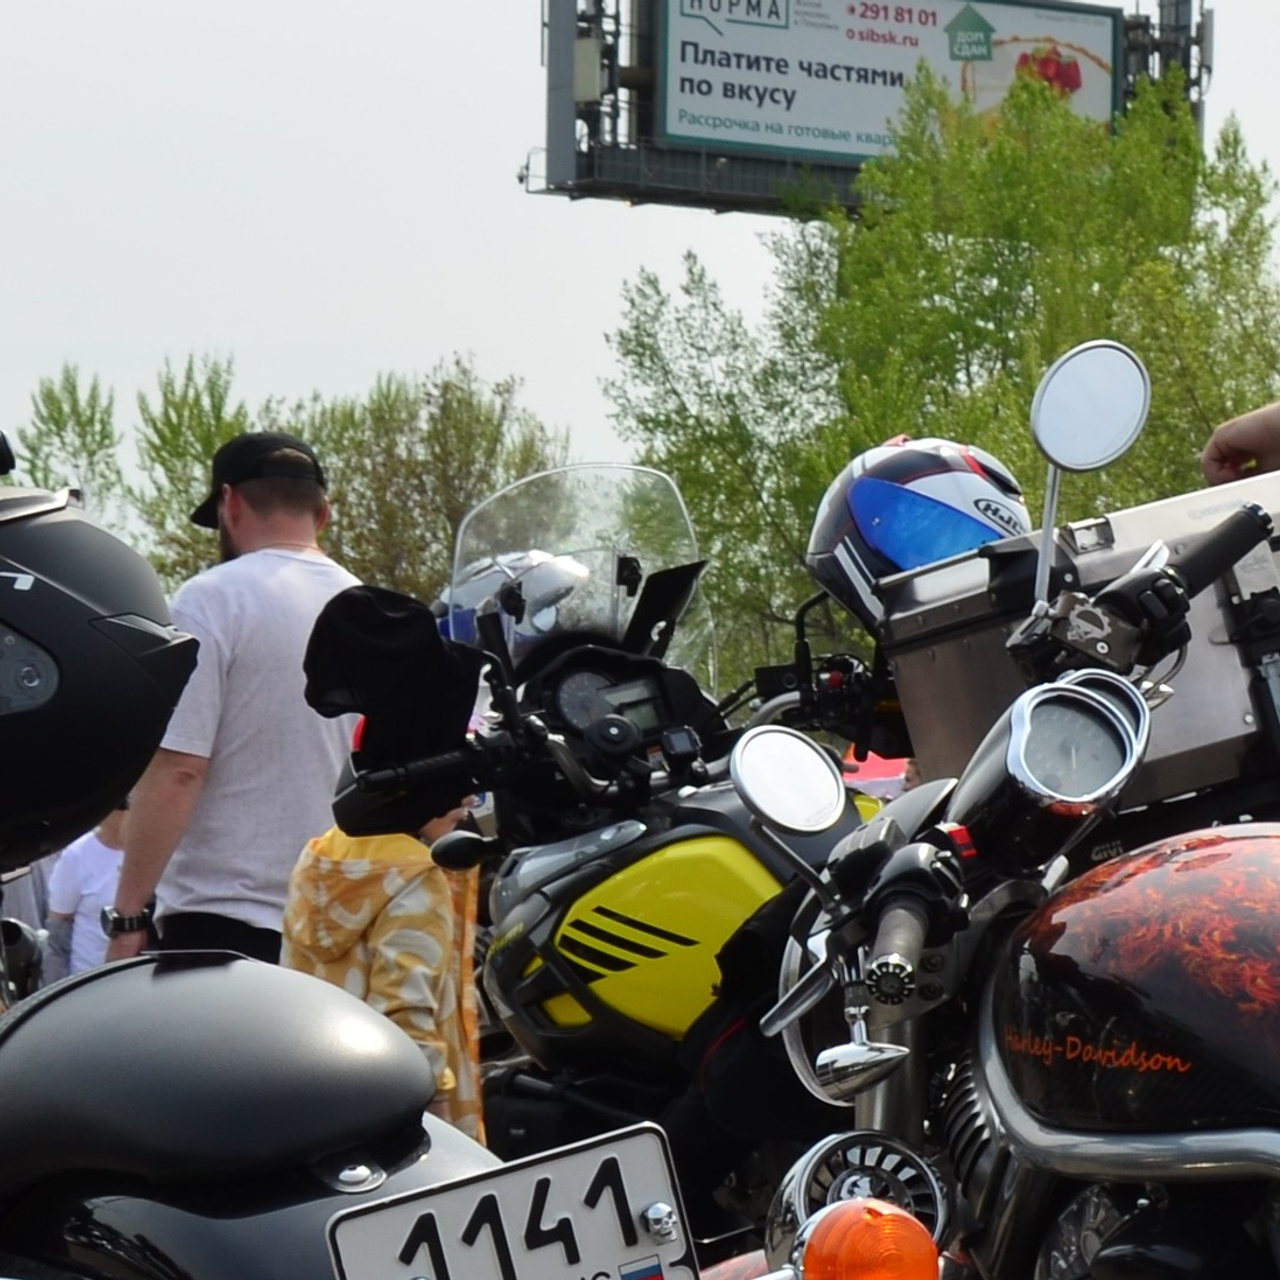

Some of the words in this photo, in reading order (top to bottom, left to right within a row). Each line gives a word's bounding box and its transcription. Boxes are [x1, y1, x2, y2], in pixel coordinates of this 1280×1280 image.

[859, 2, 889, 21] 291
[894, 5, 914, 24] 81
[918, 9, 938, 27] 01
[858, 28, 919, 47] sibsk.ru
[956, 31, 985, 44] ДОМ
[953, 44, 988, 57] СДАН
[680, 40, 789, 75] Платите
[798, 59, 904, 88] частями
[680, 76, 713, 96] по
[722, 81, 797, 111] вкусу
[678, 108, 760, 132] Рассрочка
[765, 121, 784, 135] на
[788, 123, 852, 142] готовые
[1090, 839, 1124, 861] GIVI
[1004, 1024, 1192, 1073] Harley-Davidson
